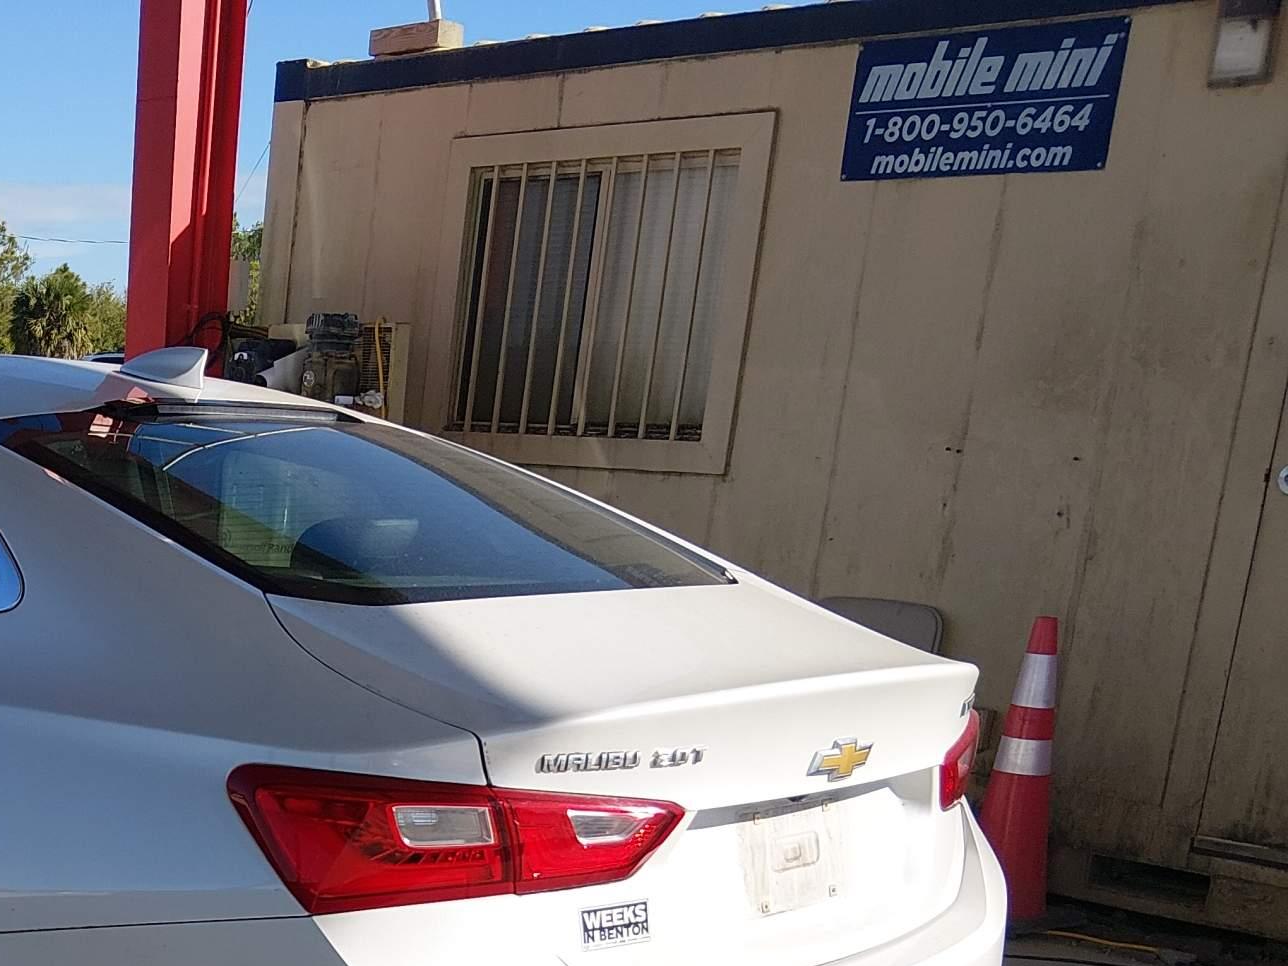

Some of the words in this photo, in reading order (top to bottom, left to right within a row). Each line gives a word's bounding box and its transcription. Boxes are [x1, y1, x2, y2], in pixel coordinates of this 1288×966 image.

[859, 37, 1004, 103] mobile
[1004, 34, 1118, 92] mini
[864, 103, 1094, 143] 1-800-950-6464
[870, 143, 1072, 174] mobilemini.com
[535, 751, 641, 774] MALIBU
[582, 904, 646, 931] WEEKS
[600, 922, 649, 941] BENTON
